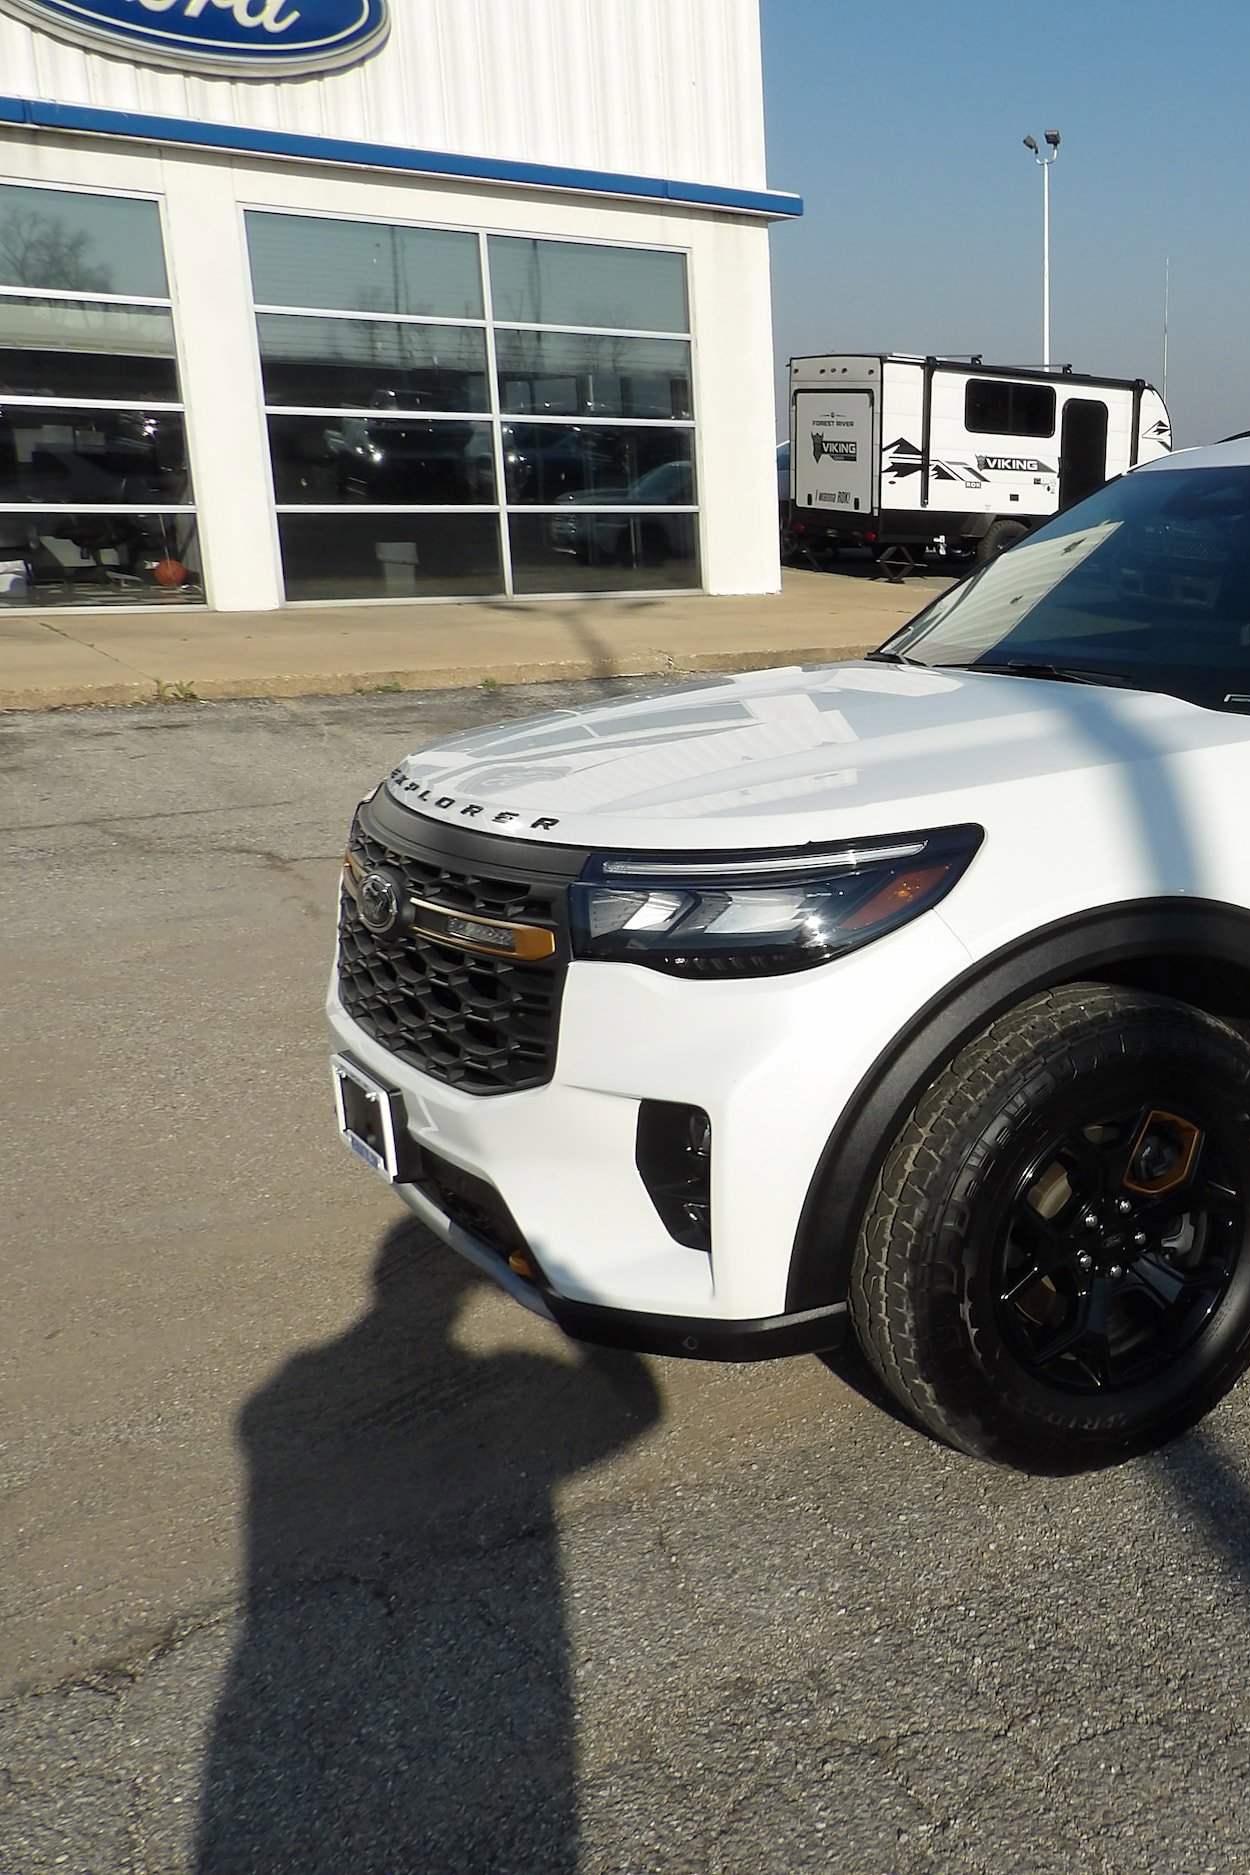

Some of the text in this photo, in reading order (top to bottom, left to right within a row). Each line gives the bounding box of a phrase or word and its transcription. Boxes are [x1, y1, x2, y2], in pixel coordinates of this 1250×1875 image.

[823, 442, 856, 453] VIKING
[986, 457, 1038, 471] VIKING
[391, 768, 560, 831] EXPLORER
